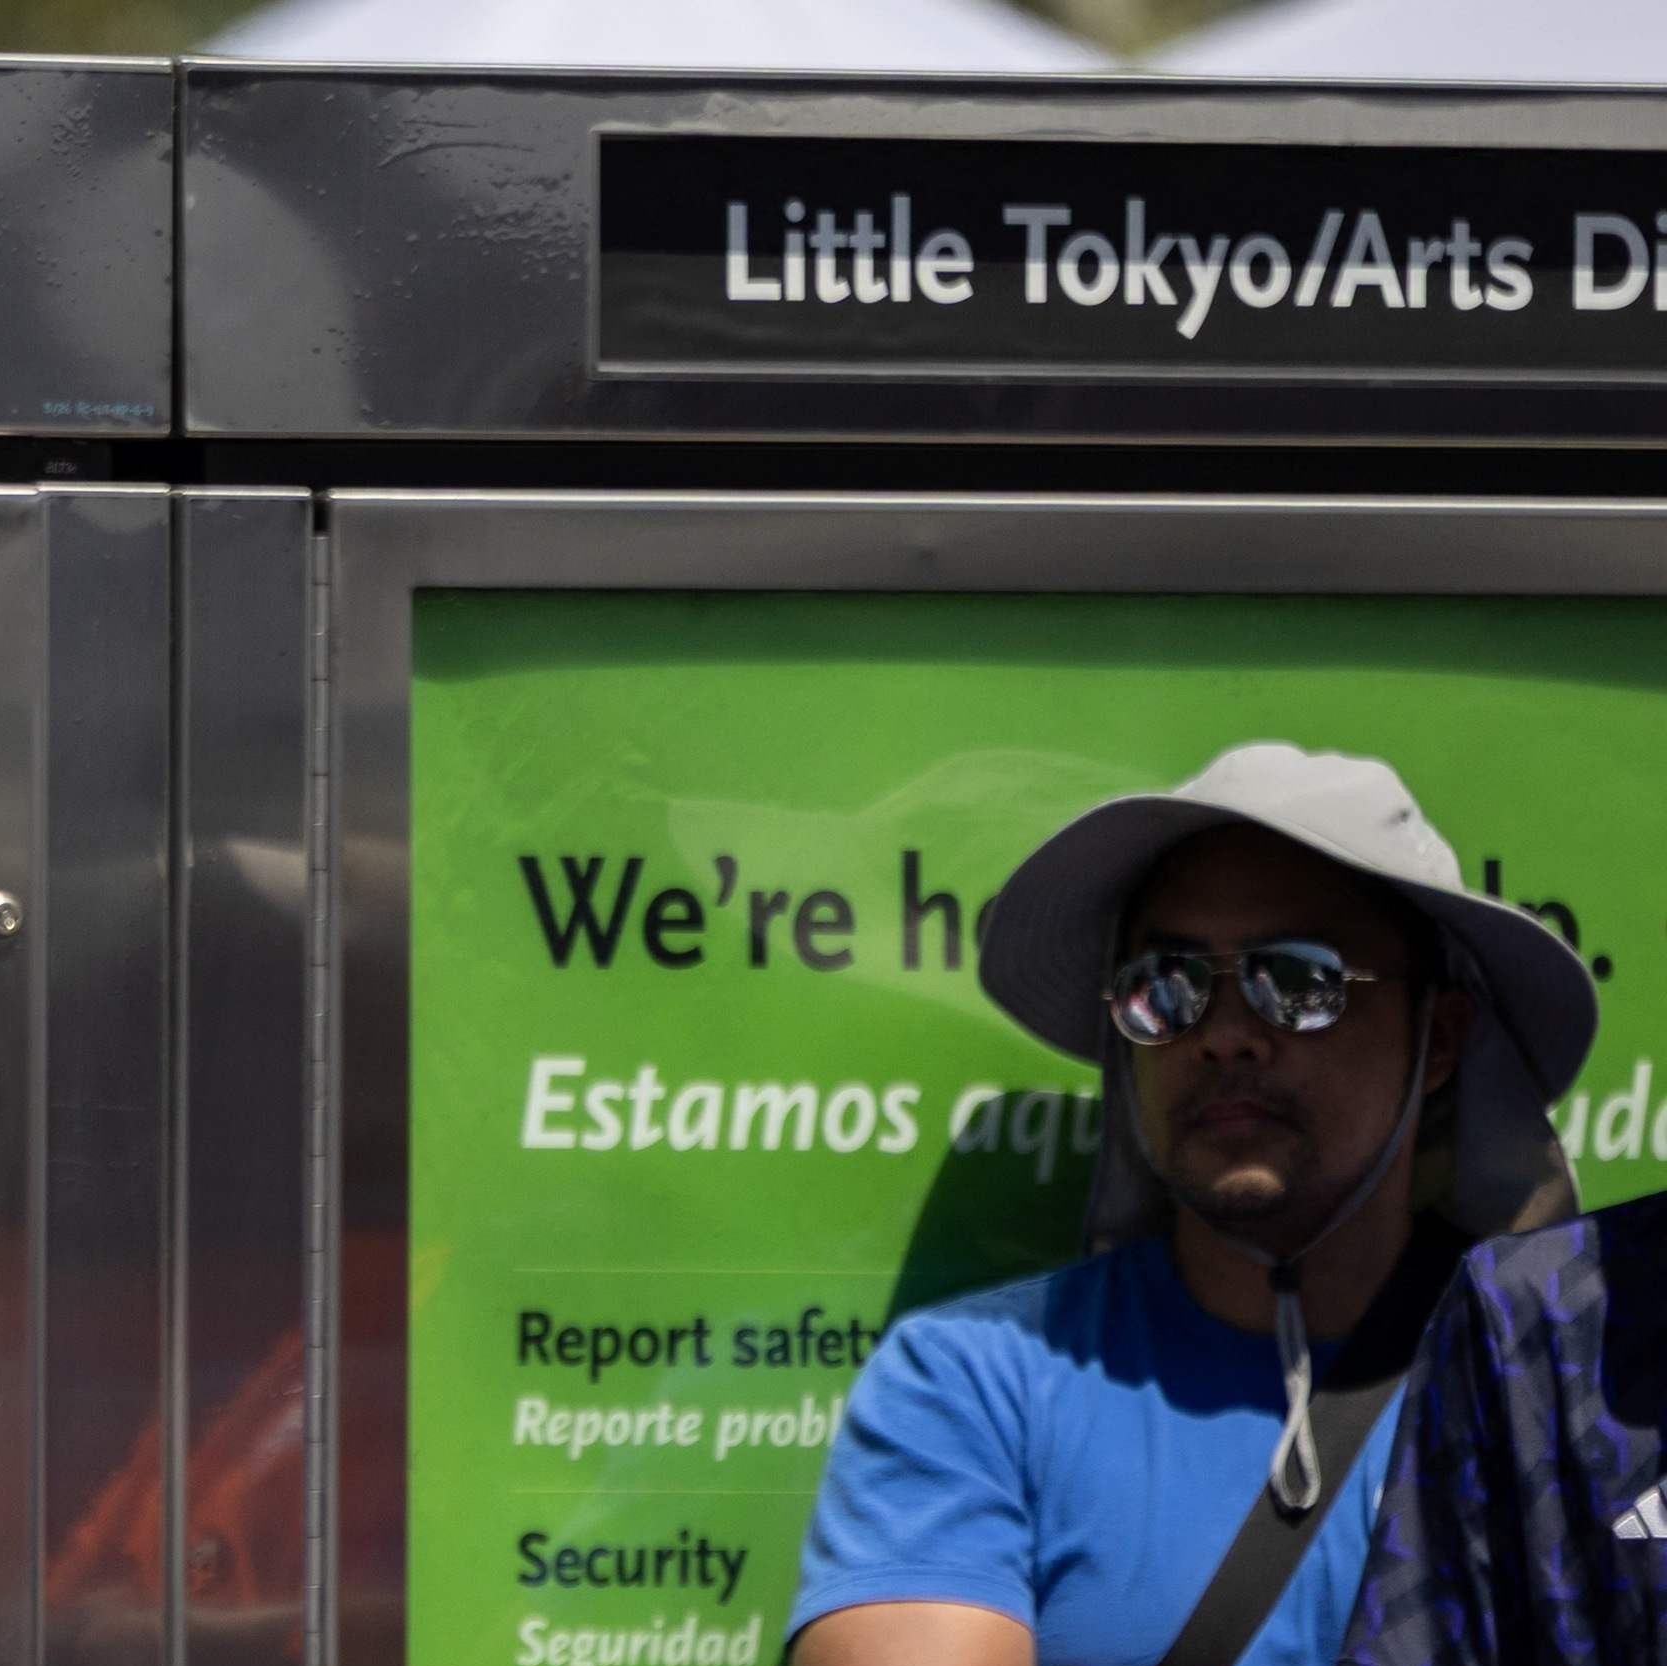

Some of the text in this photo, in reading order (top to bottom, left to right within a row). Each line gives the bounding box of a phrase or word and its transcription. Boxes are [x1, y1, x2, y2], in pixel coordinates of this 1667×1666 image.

[725, 191, 973, 306] Little
[1002, 202, 1533, 338] Tokyo/Arts
[518, 853, 855, 972] We’re
[520, 1054, 922, 1154] Estamos
[949, 1084, 1103, 1185] aqu
[517, 1311, 713, 1383] Report
[513, 1395, 845, 1462] Reporte probl
[518, 1530, 749, 1603] Security
